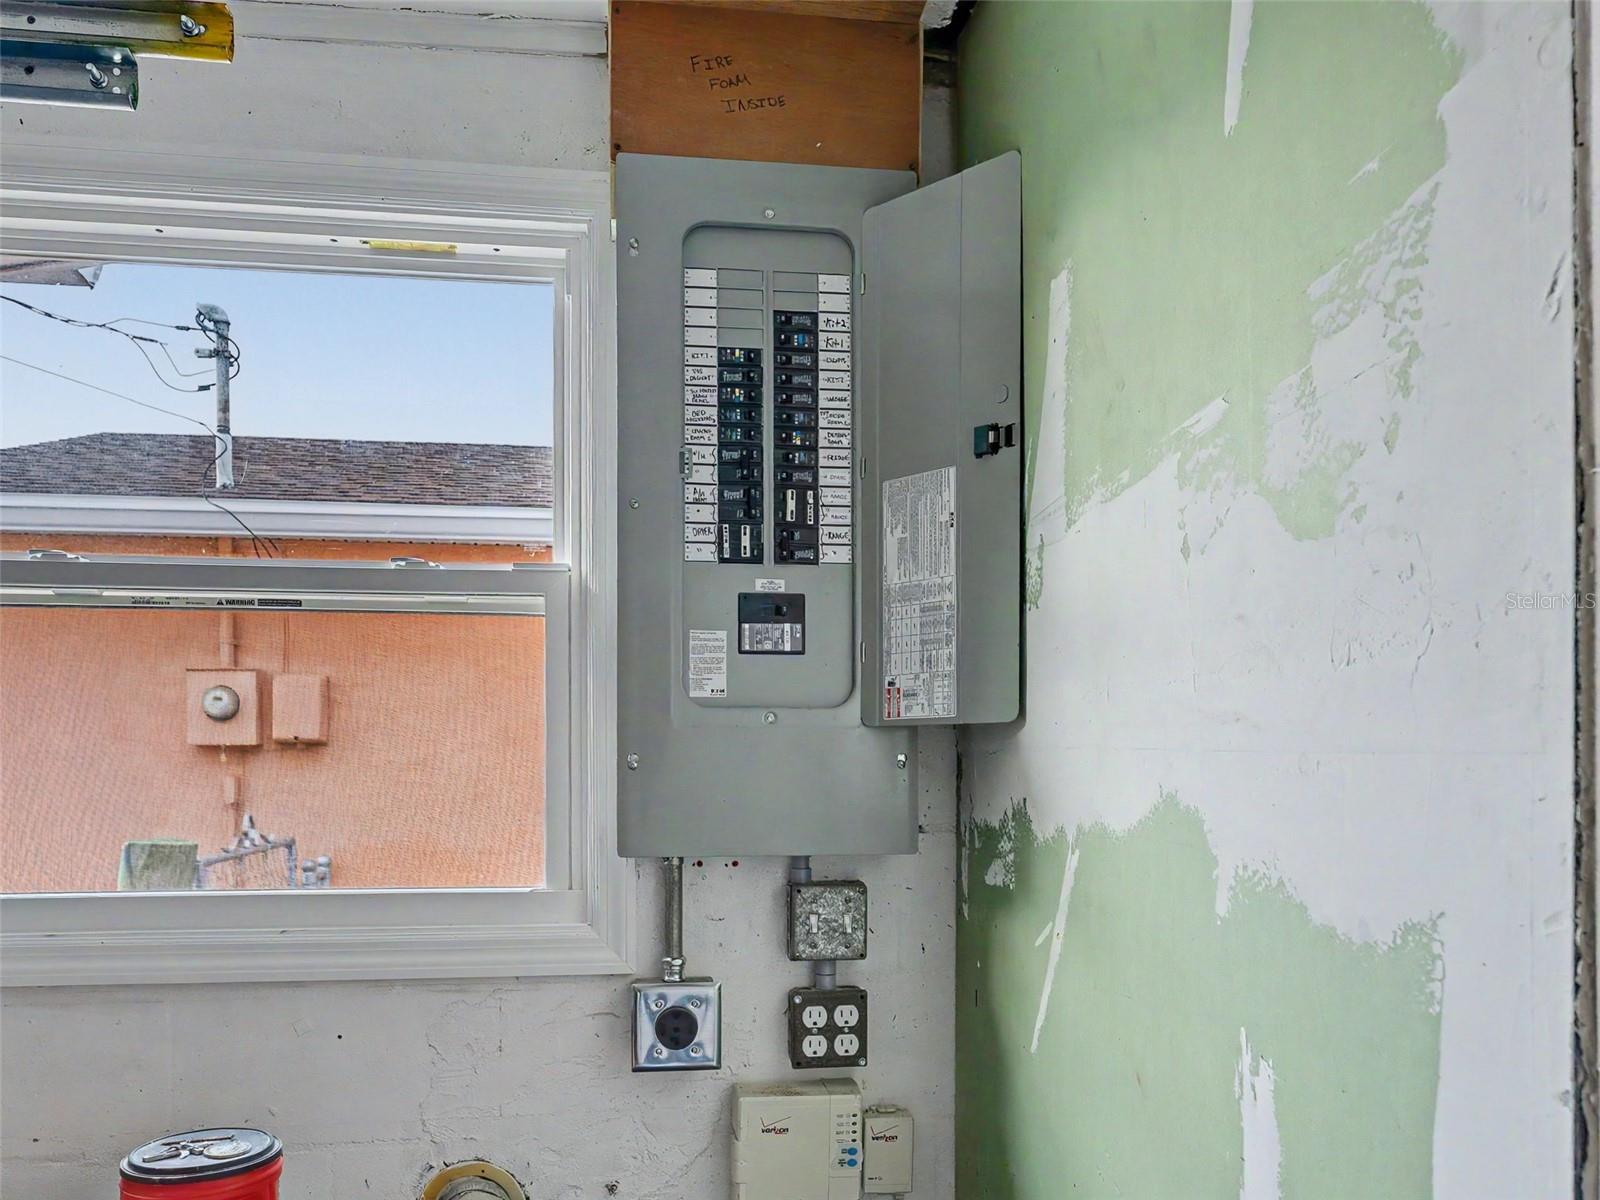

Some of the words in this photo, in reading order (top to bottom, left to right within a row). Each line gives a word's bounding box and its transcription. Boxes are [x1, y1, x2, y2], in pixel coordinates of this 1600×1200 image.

[690, 55, 733, 73] FIRE
[708, 73, 751, 91] FOAM
[720, 95, 786, 113] INSIDE
[761, 1126, 789, 1135] verizon
[871, 1134, 898, 1142] verizon
